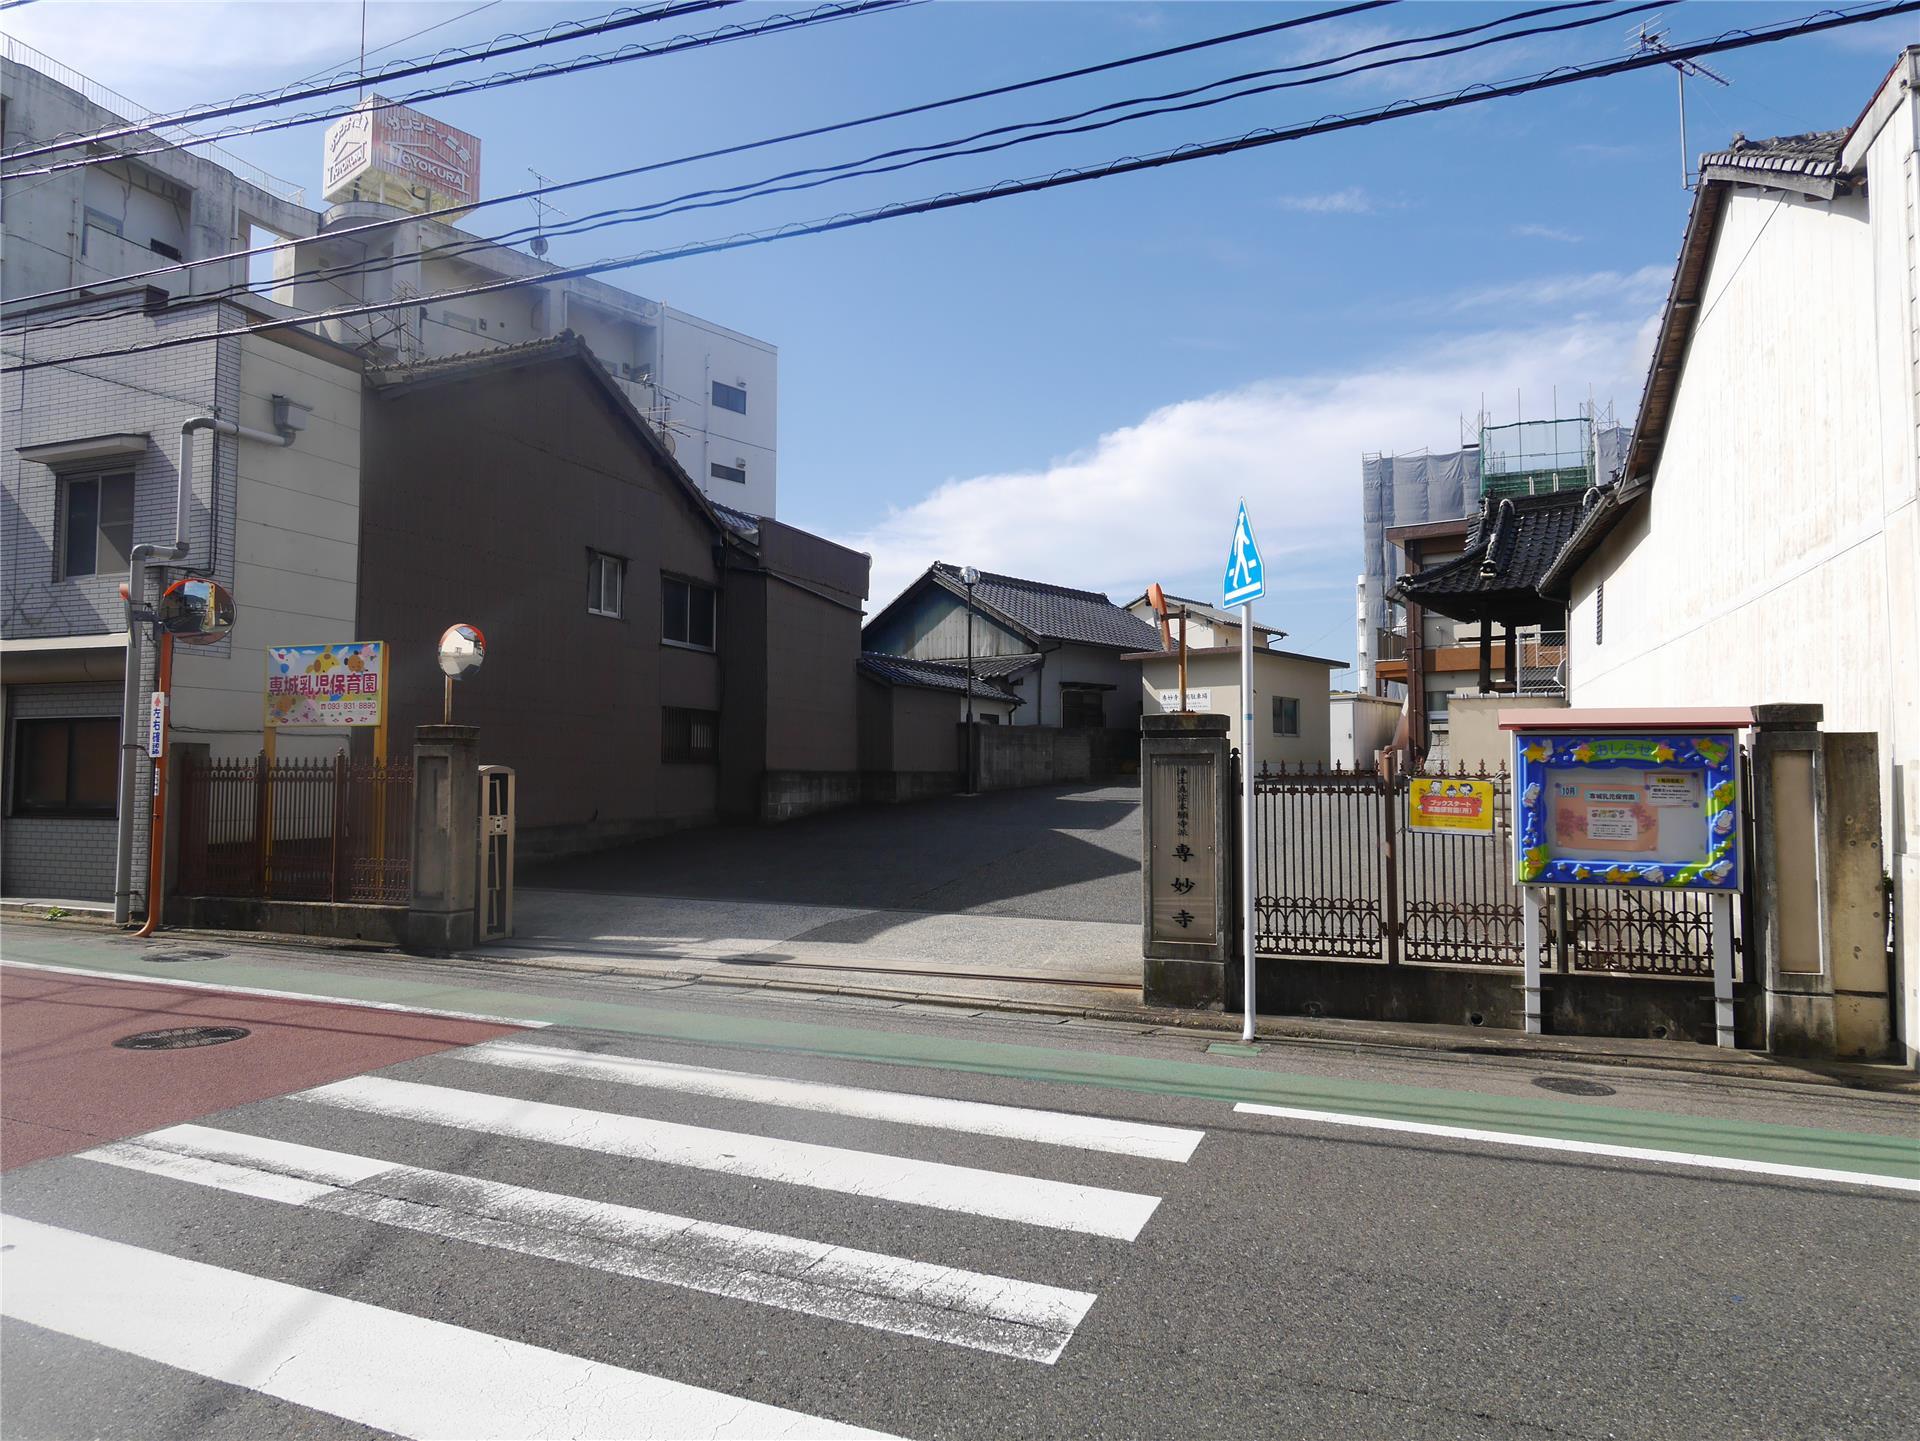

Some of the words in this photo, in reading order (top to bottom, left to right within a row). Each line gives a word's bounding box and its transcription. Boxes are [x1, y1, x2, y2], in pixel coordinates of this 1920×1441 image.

[390, 145, 462, 185] TOYOKURA
[269, 673, 378, 696] 専城乳児保育園
[151, 708, 161, 754] 左右確認
[1595, 743, 1652, 756] おしらせ
[1429, 799, 1472, 807] ブックスタート
[1170, 843, 1196, 929] 専妙寺
